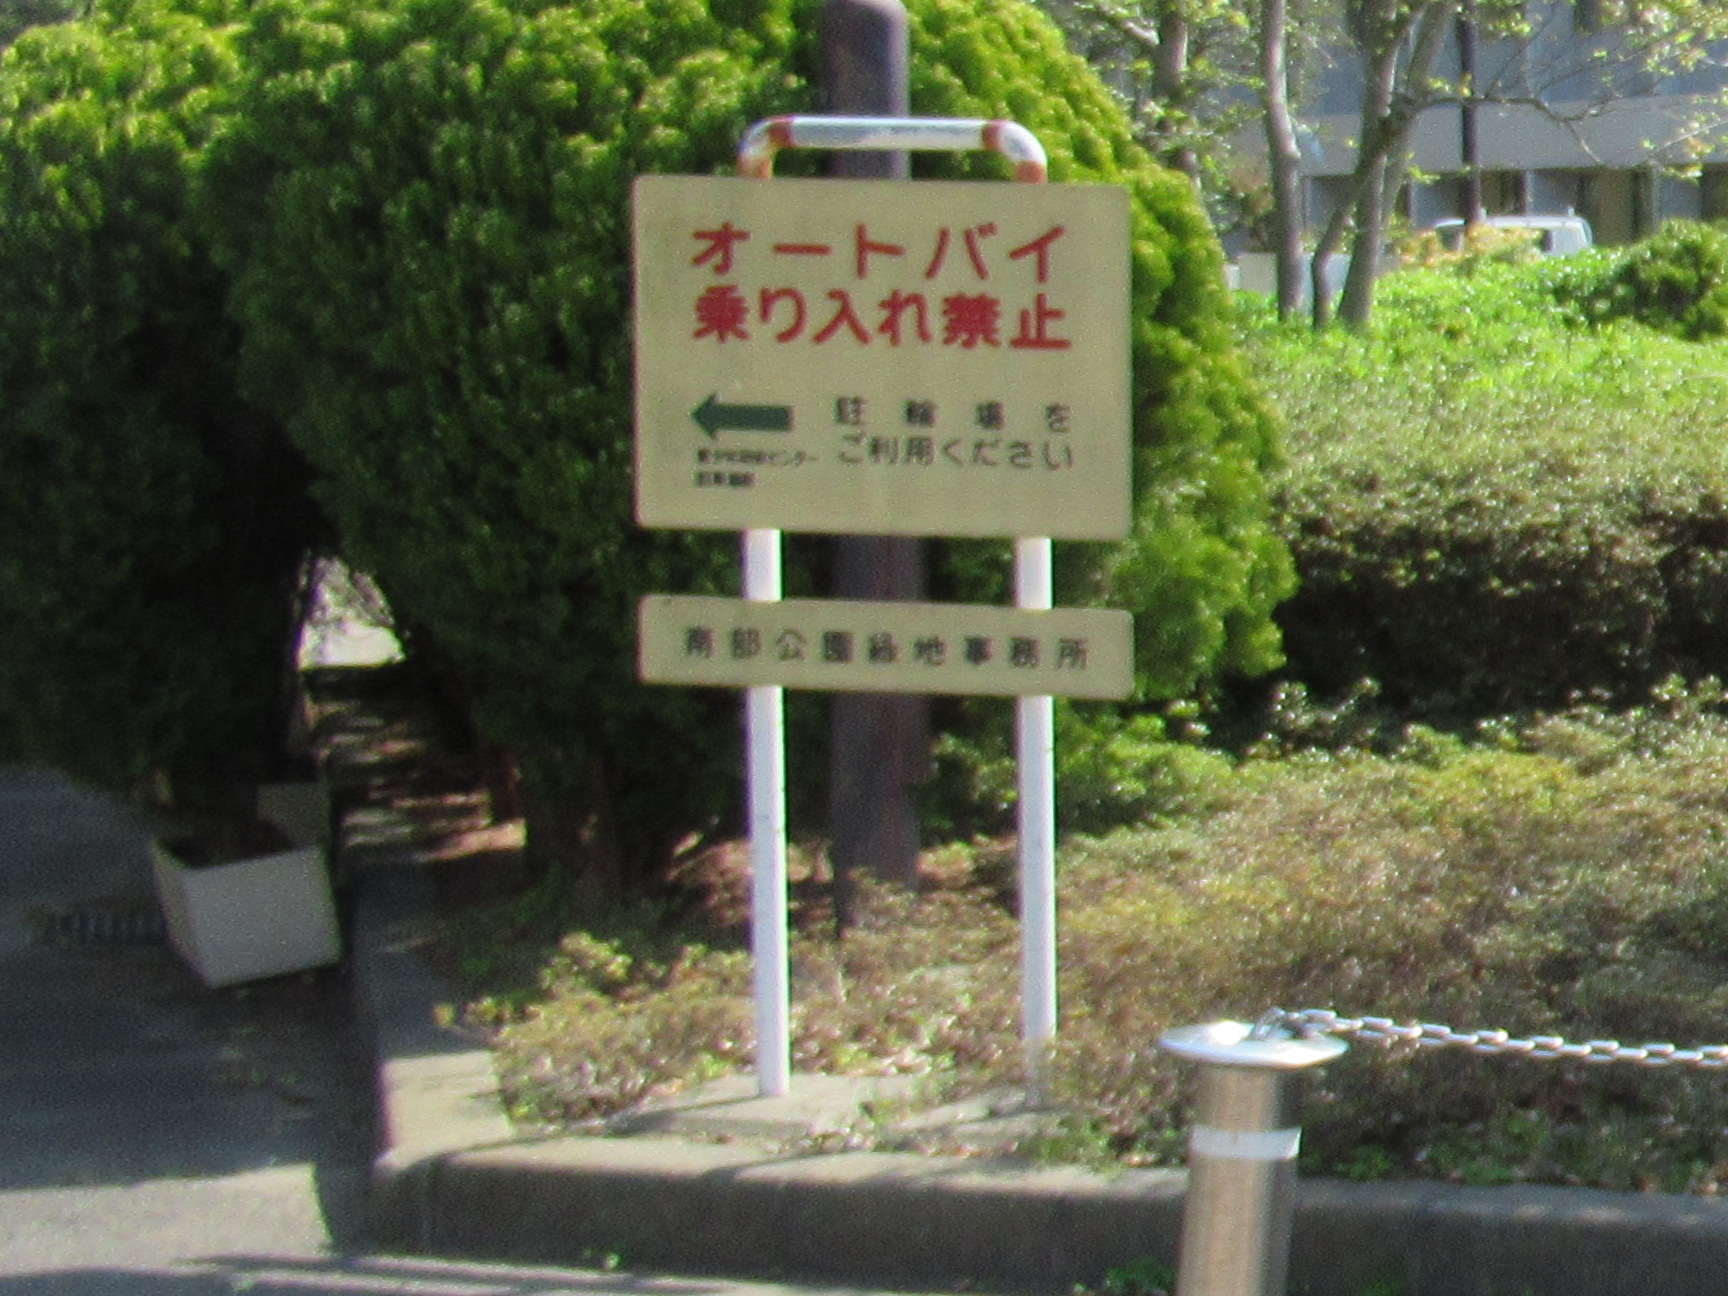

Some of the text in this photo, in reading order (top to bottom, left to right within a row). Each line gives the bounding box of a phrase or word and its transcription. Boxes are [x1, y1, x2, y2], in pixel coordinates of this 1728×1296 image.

[692, 222, 1066, 284] オートバイ
[693, 285, 1072, 350] 乗り入れ禁止
[837, 431, 1074, 471] ご利用ください
